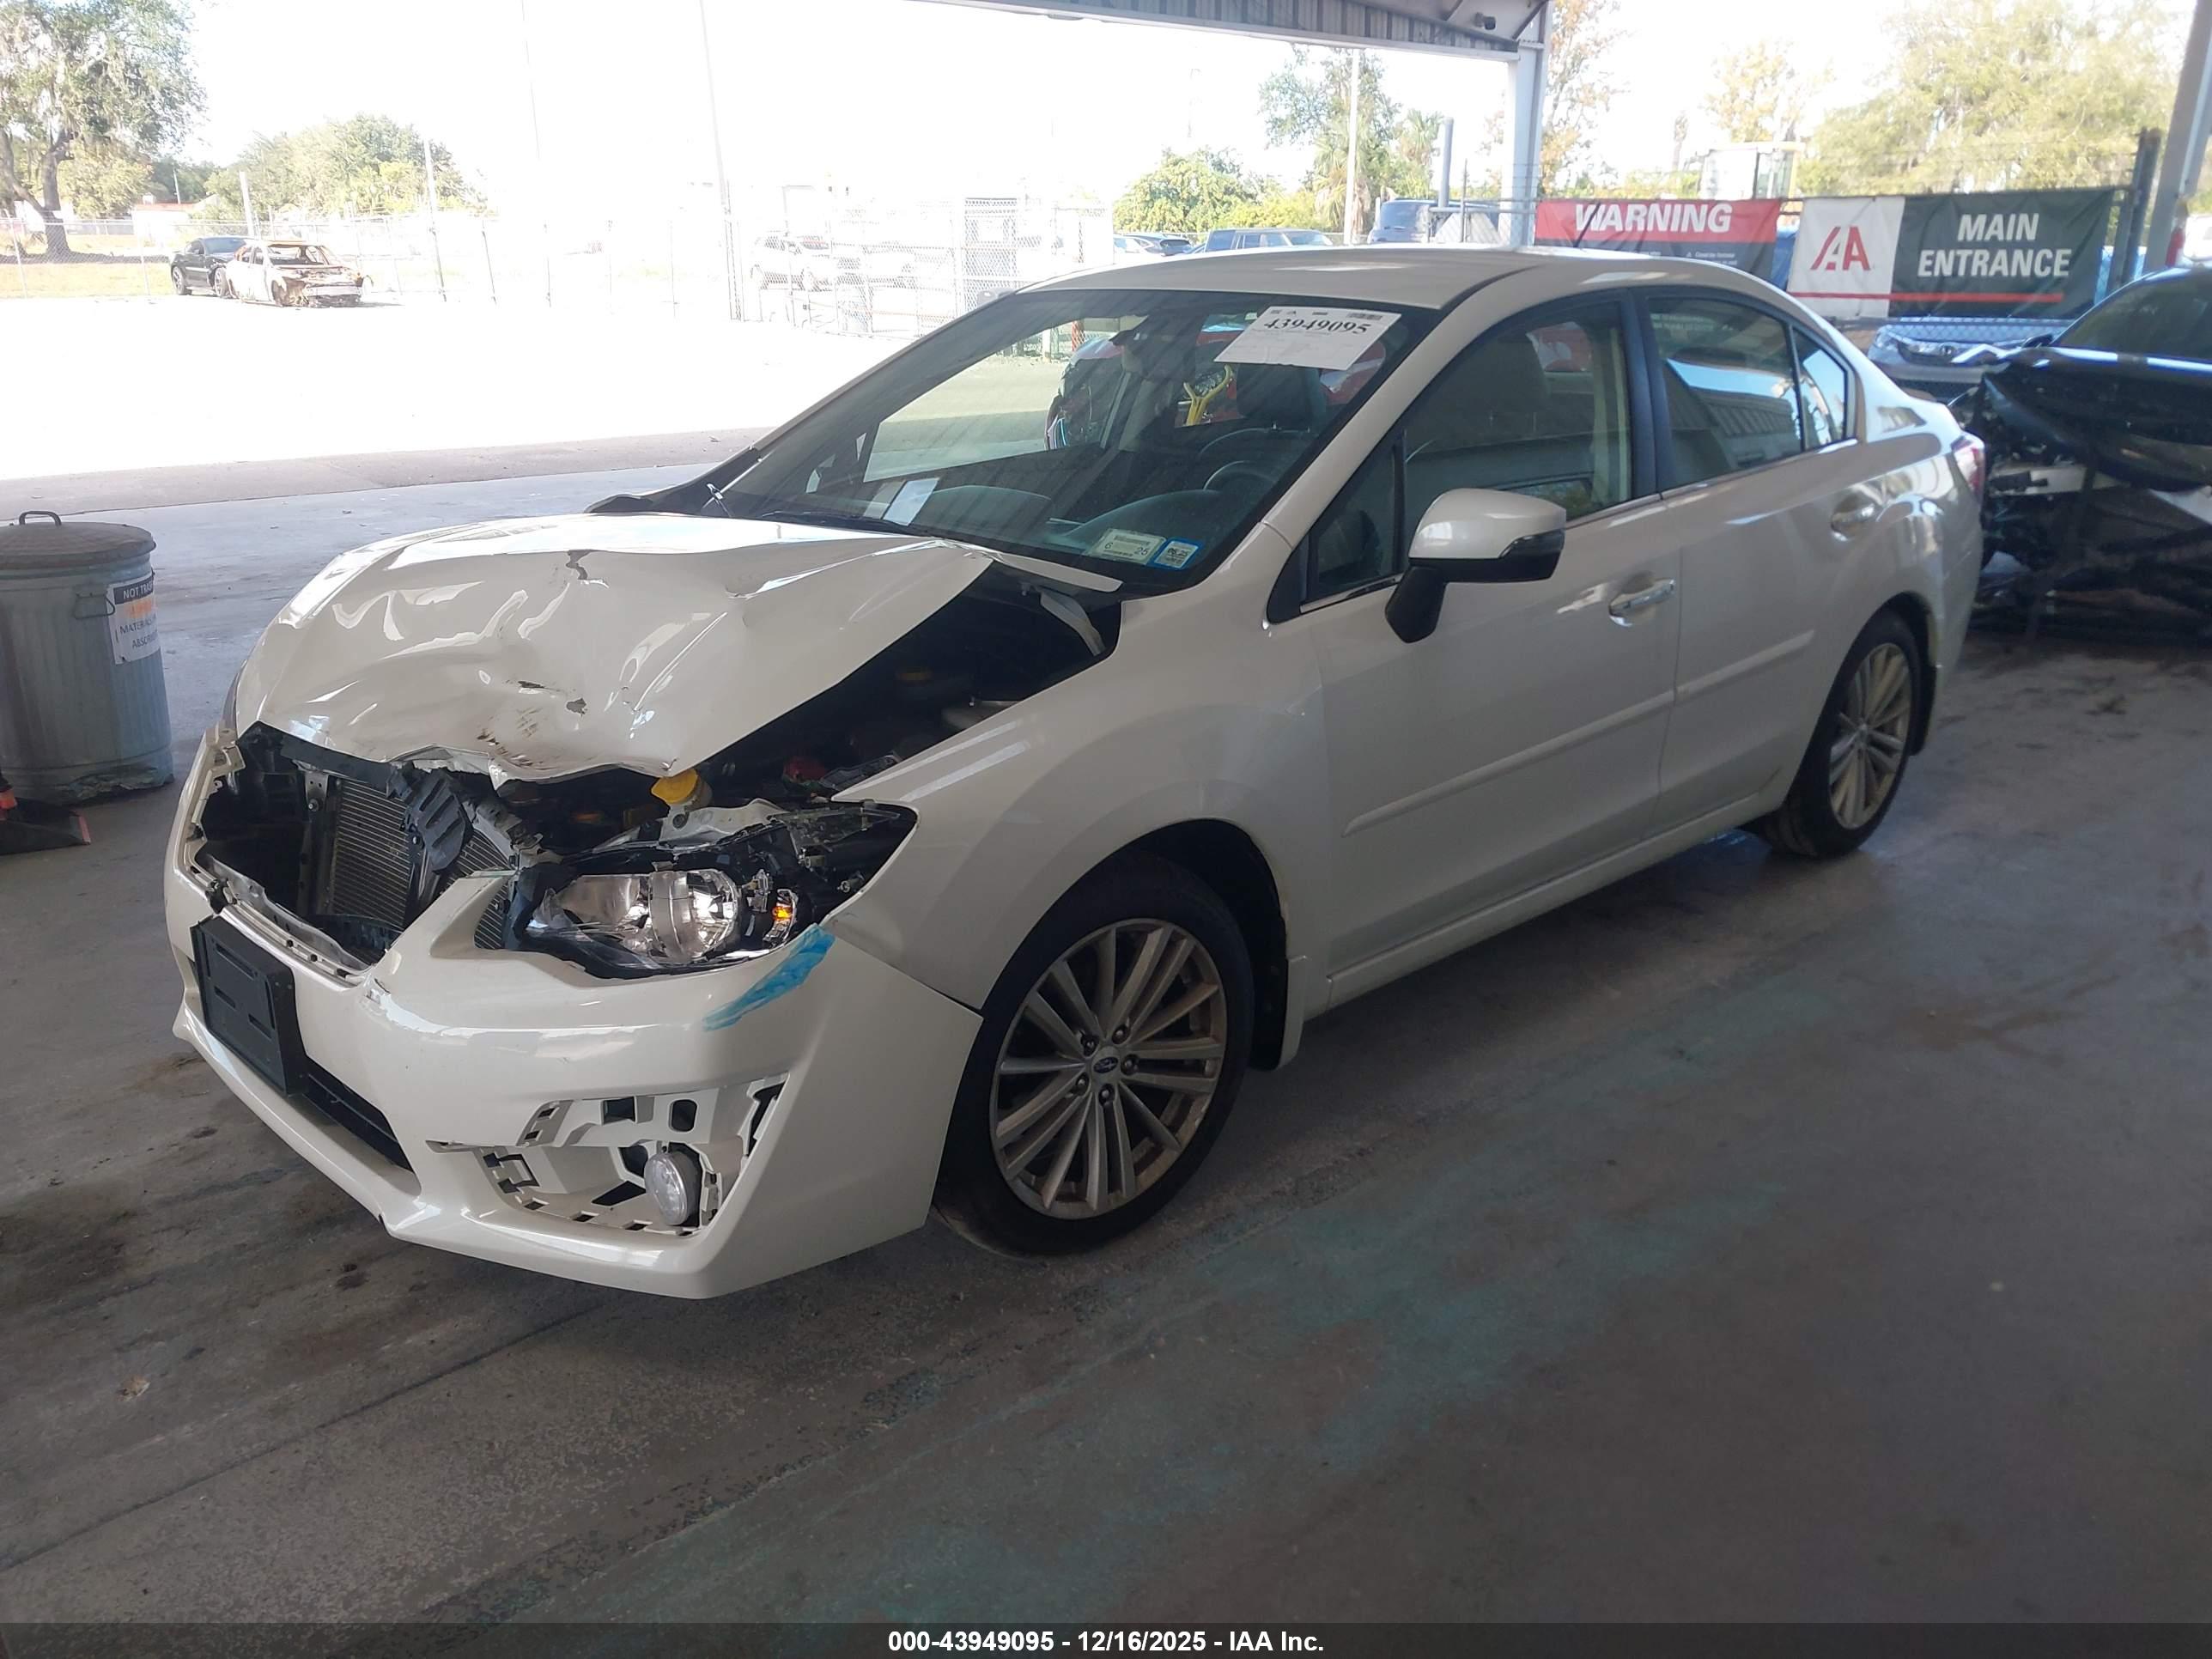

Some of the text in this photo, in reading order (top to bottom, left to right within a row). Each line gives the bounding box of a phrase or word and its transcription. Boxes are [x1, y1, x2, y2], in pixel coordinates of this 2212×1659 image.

[1575, 204, 1733, 233] WARNING
[1958, 213, 2039, 241] MAIN
[1917, 248, 2072, 277] ENTRANCE
[1264, 319, 1371, 334] 43949095
[123, 586, 138, 599] NOT
